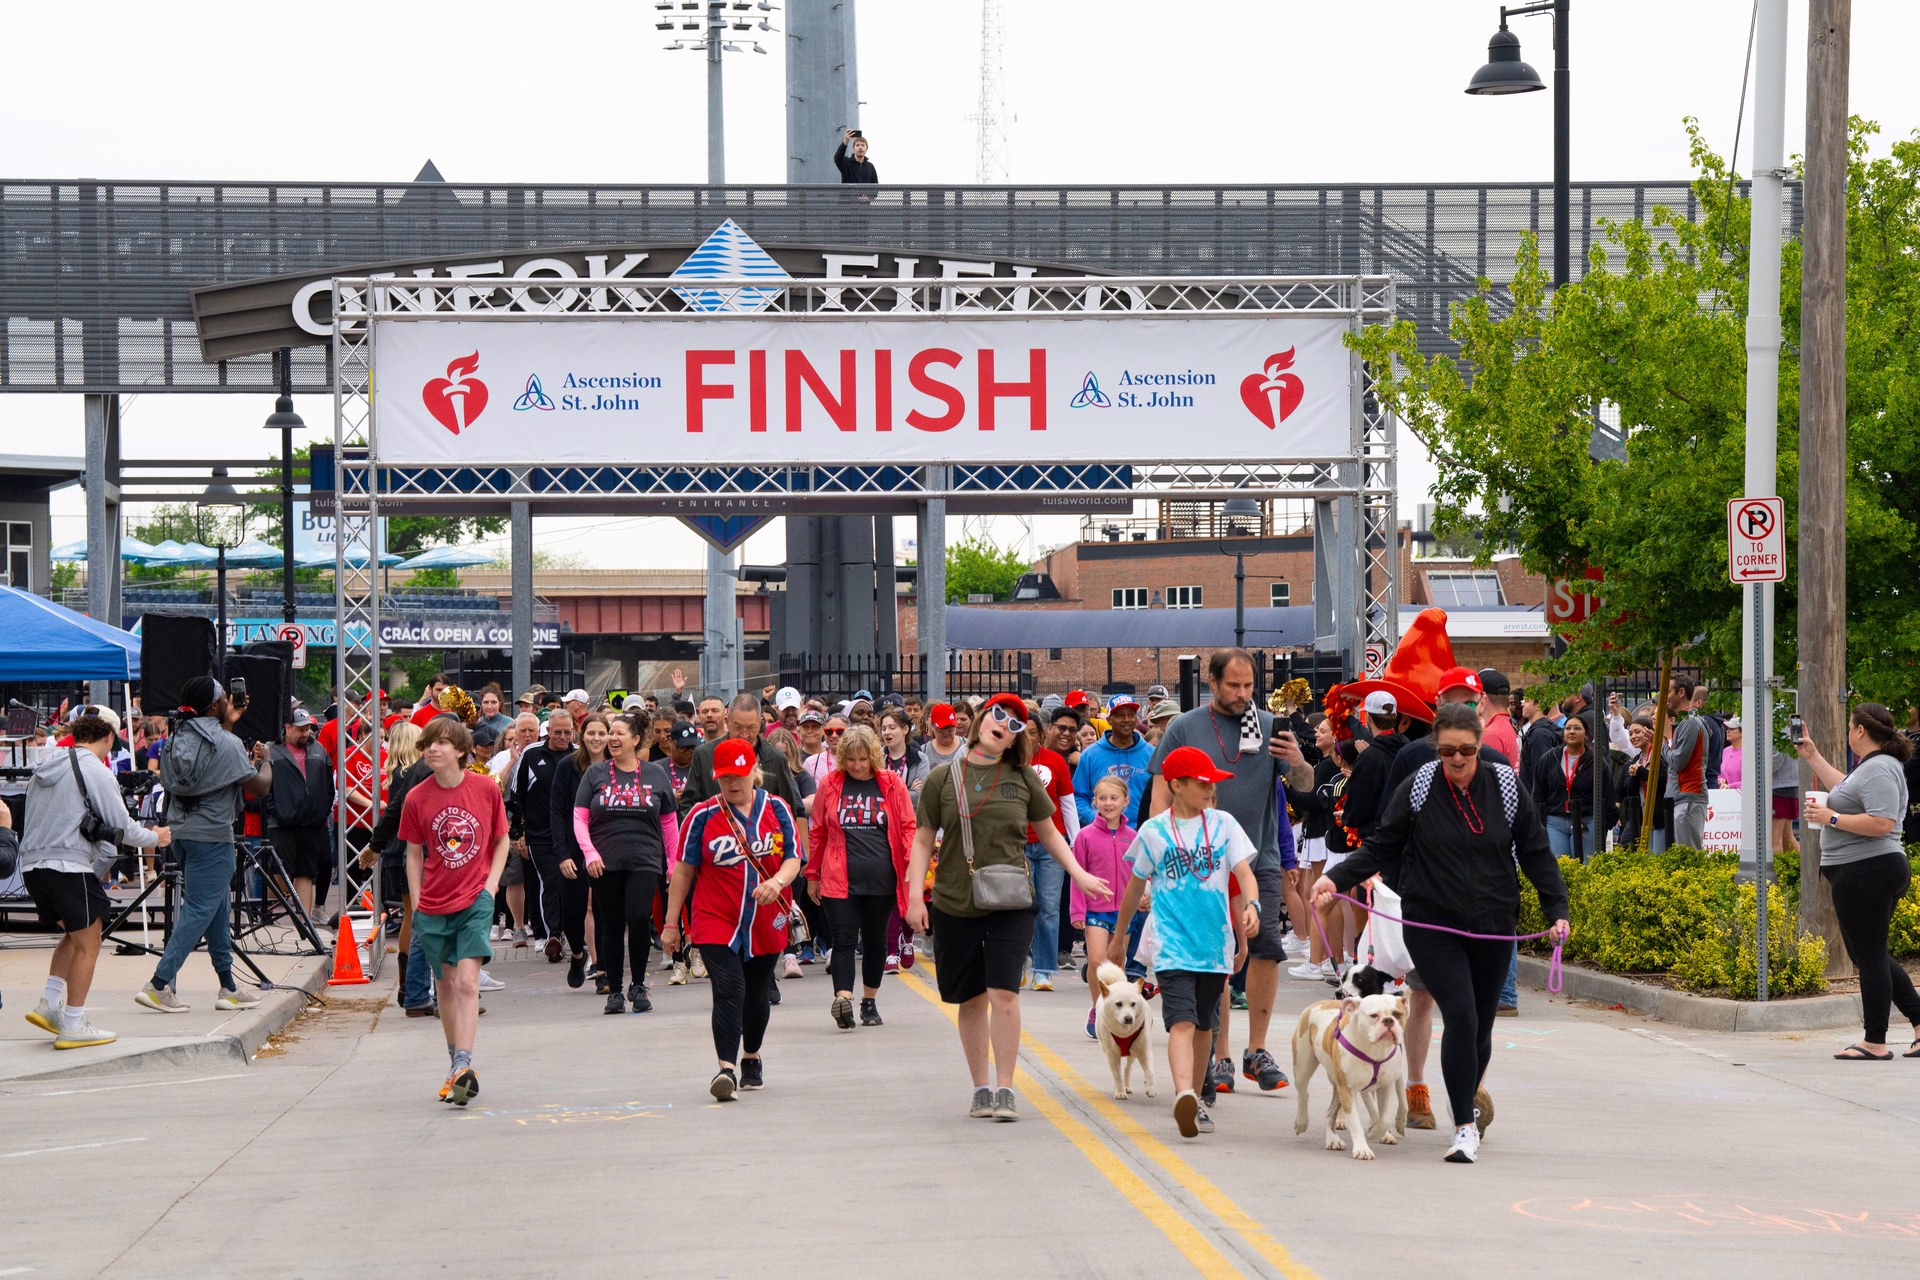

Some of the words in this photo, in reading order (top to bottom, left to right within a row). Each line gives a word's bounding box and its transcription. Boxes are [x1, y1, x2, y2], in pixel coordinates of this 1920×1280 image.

[292, 253, 649, 336] ONEOK
[562, 372, 662, 389] Ascension
[1118, 369, 1217, 386] Ascension
[685, 348, 1047, 433] FINISH
[562, 394, 587, 411] St.
[591, 394, 640, 411] John
[1118, 391, 1143, 408] St.
[1146, 391, 1194, 408] John
[677, 499, 770, 508] ENTRANCE
[1042, 496, 1128, 506] tulsaworld.com
[1750, 542, 1764, 553] TO
[1736, 553, 1778, 566] CORNER
[243, 625, 335, 644] LANNG
[382, 626, 431, 642] CRACK
[433, 628, 472, 642] OPEN
[475, 628, 485, 642] A
[488, 628, 514, 642] COL
[837, 794, 885, 811] EART
[432, 809, 448, 830] WALK
[447, 806, 459, 815] TO
[460, 810, 480, 828] CURE
[1703, 831, 1742, 840] ELCOM
[450, 844, 480, 869] DISEASE
